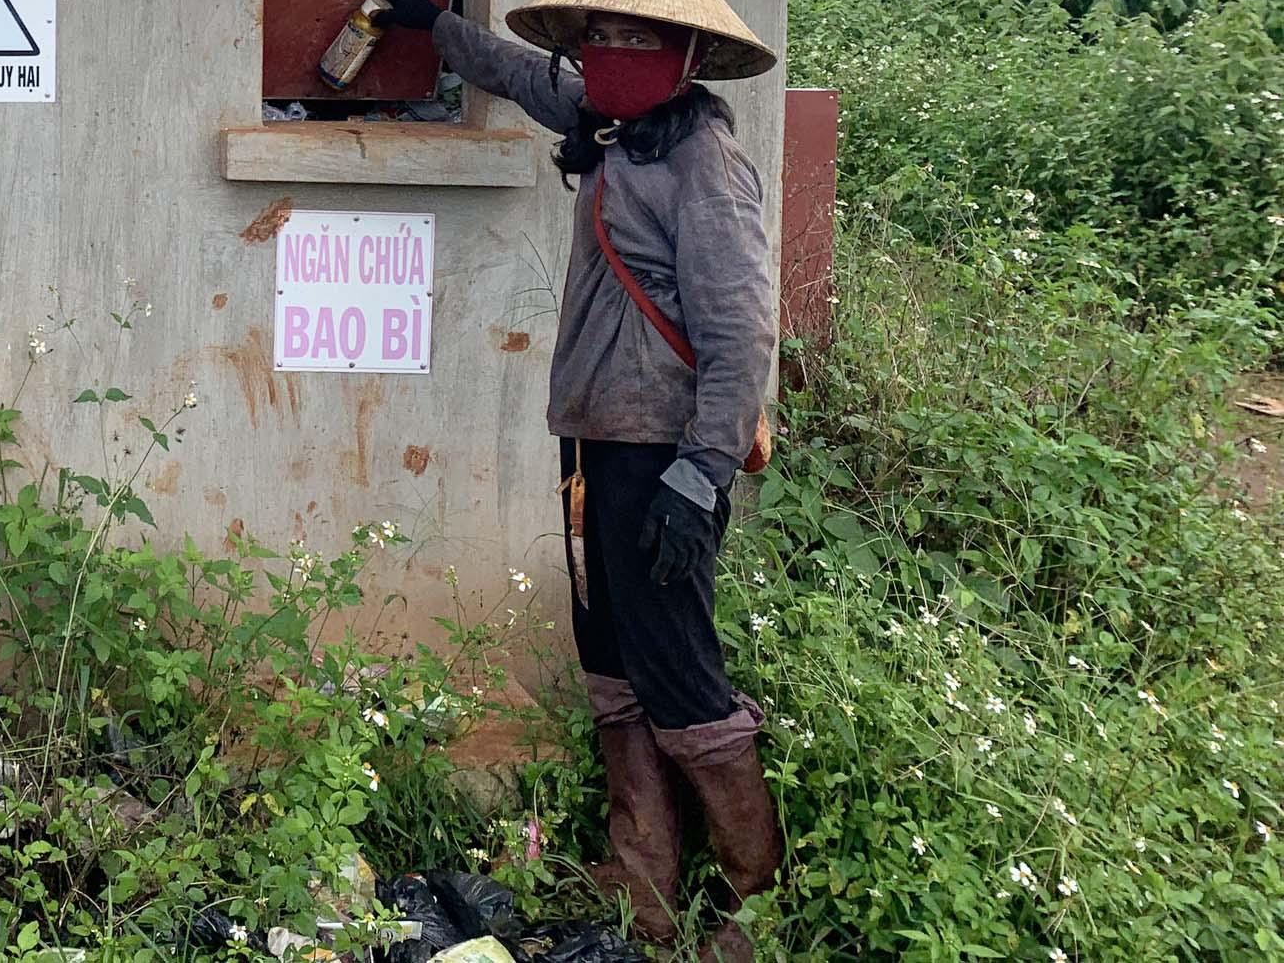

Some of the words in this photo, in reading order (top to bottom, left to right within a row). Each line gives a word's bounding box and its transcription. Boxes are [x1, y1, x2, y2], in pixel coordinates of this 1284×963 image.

[18, 65, 40, 93] HẠI
[284, 223, 350, 284] NGĂN
[358, 222, 425, 285] CHỨA
[283, 306, 366, 360] BAO
[381, 294, 422, 361] BÌ
